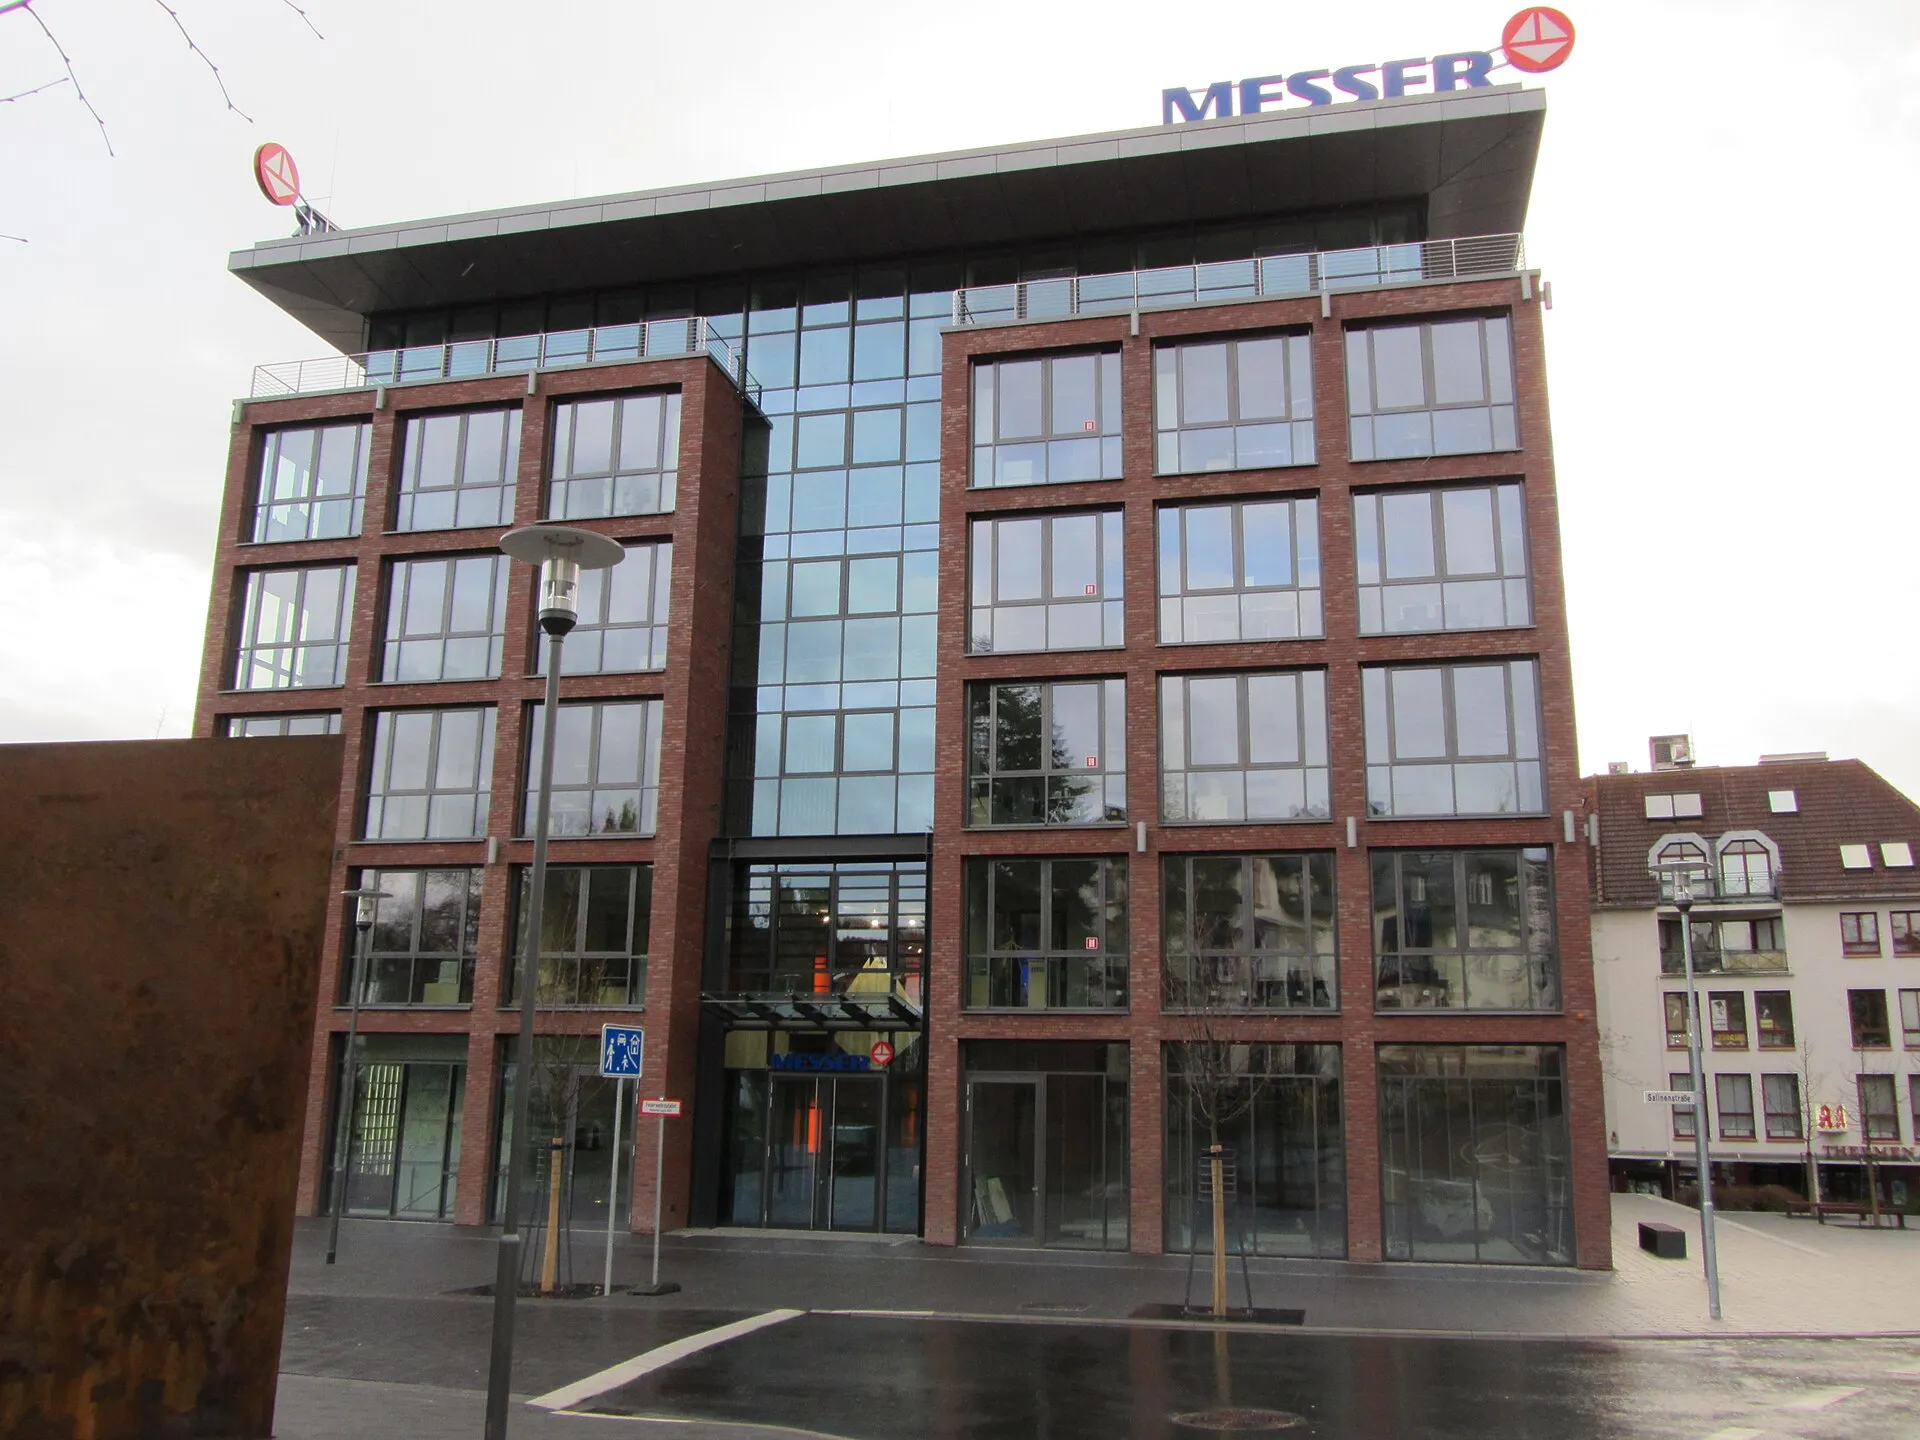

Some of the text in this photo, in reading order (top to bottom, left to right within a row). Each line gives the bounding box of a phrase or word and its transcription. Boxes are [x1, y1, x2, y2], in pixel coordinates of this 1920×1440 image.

[1162, 50, 1494, 124] MESSER
[771, 1052, 870, 1071] MESSER
[1647, 1093, 1691, 1103] Salinenstraße
